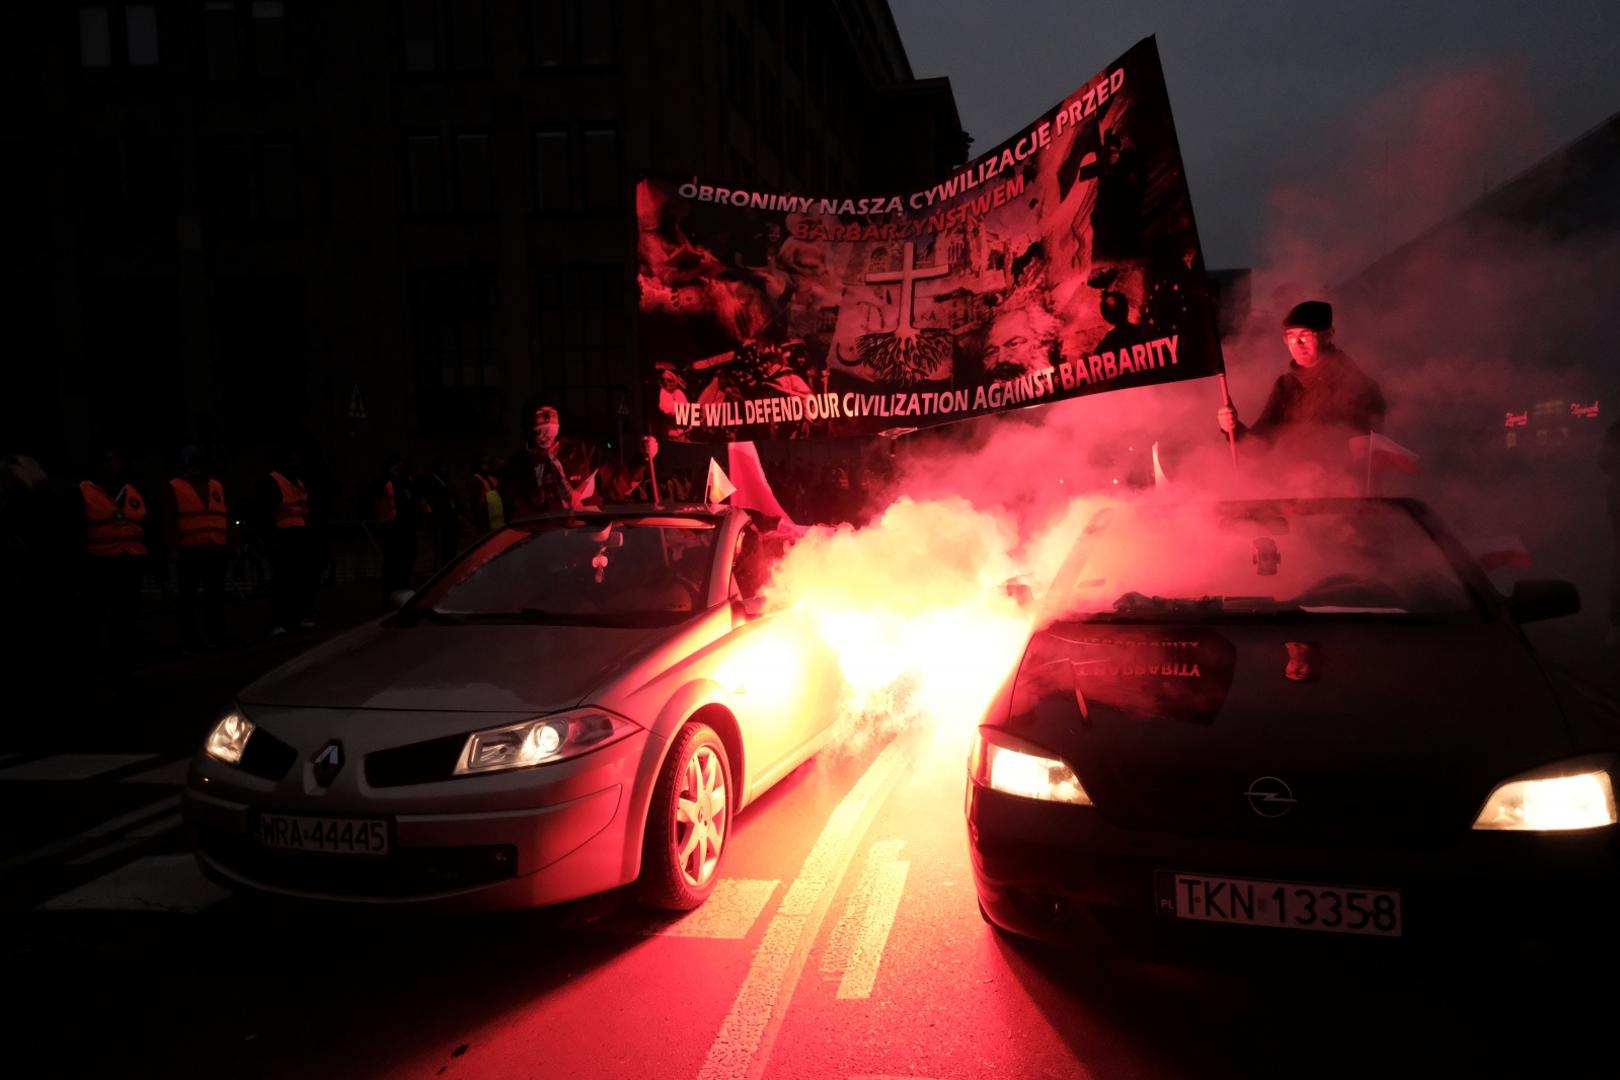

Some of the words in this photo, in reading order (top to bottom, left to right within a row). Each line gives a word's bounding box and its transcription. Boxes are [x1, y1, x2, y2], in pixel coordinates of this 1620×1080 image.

[677, 182, 815, 214] OBRONIMY
[819, 195, 904, 217] NASZĄ
[909, 122, 1052, 210] CYWILIZACJĘ
[1056, 67, 1126, 136] PRZED
[674, 402, 701, 427] WE
[704, 401, 744, 427] WILL
[744, 396, 804, 425] DEFEND
[806, 392, 841, 420] OUR
[842, 389, 968, 418] CIVILIZATION
[972, 366, 1055, 410] AGAINST
[1058, 335, 1180, 391] BARBARITY
[262, 817, 303, 849] WRA
[311, 821, 385, 851] 44445
[1178, 878, 1254, 920] TKN
[1272, 887, 1396, 931] 13358
